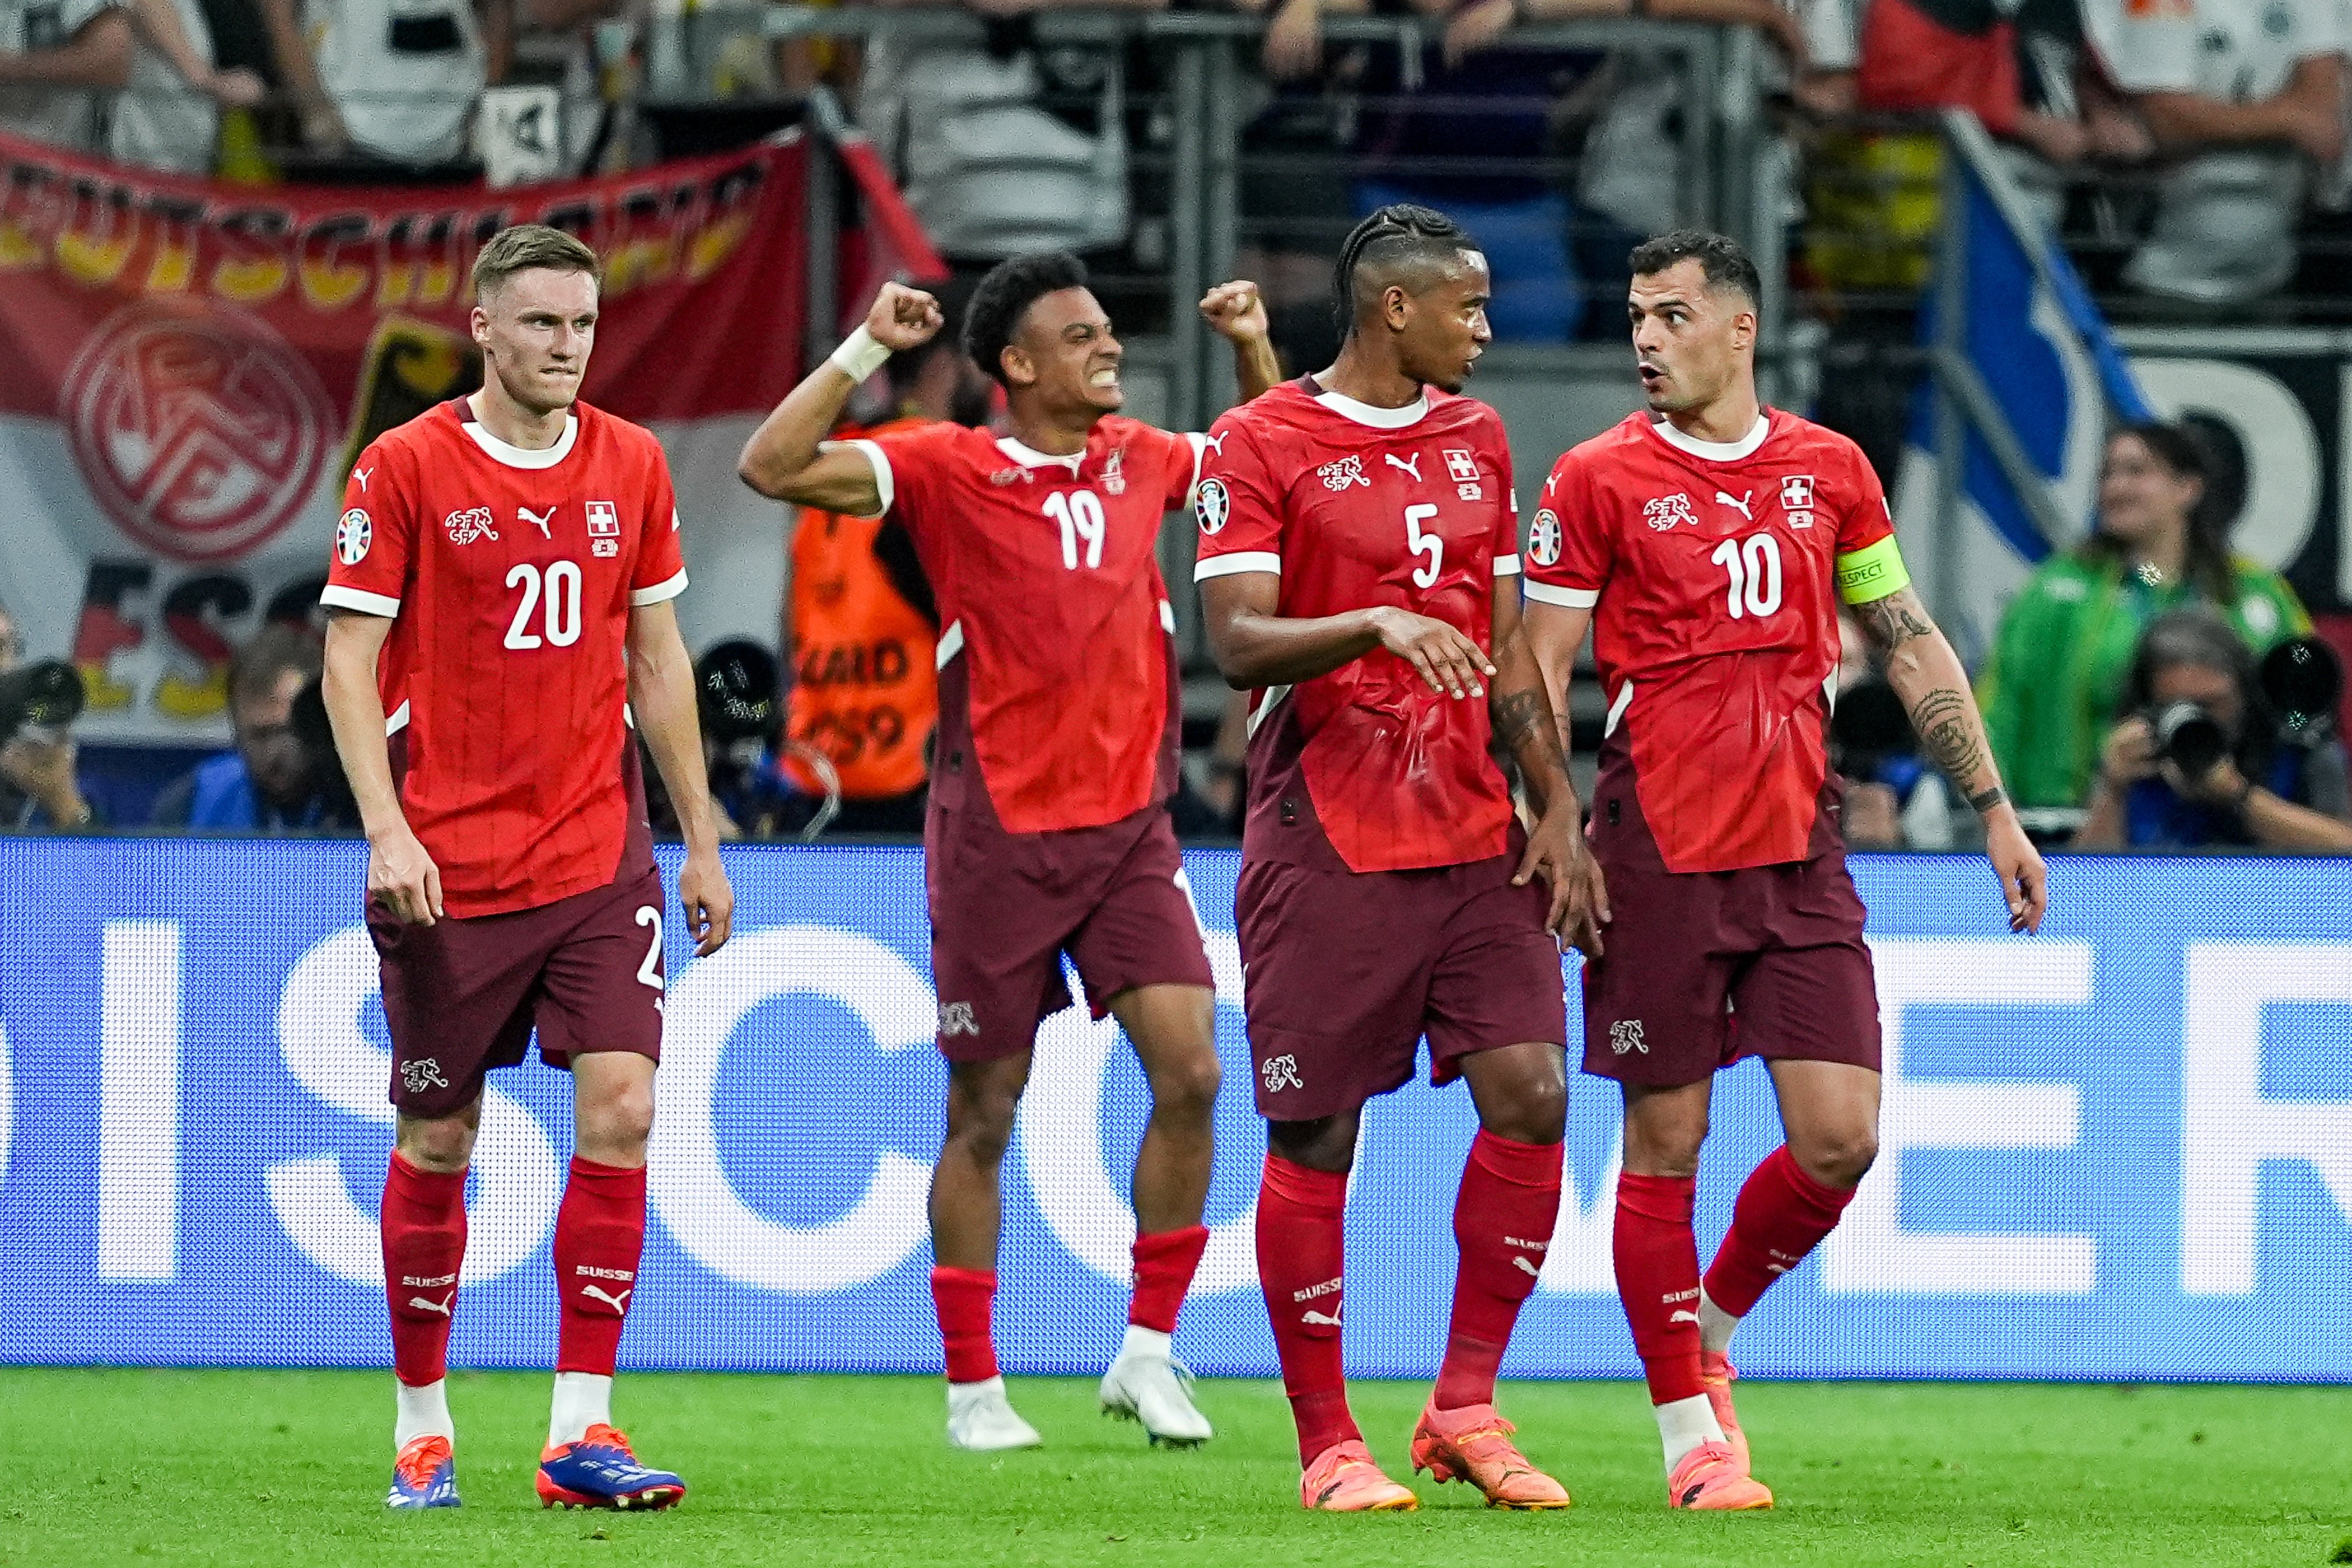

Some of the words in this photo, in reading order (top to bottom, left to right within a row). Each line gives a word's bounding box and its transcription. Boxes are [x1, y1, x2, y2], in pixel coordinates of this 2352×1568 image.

[1042, 489, 1105, 570] 19
[1404, 504, 1444, 589] 5
[504, 560, 582, 650] 20
[1711, 533, 1782, 619] 10
[0, 917, 2352, 1298] ISCOER
[402, 1268, 456, 1287] SUISSE
[576, 1264, 634, 1282] SUISSE
